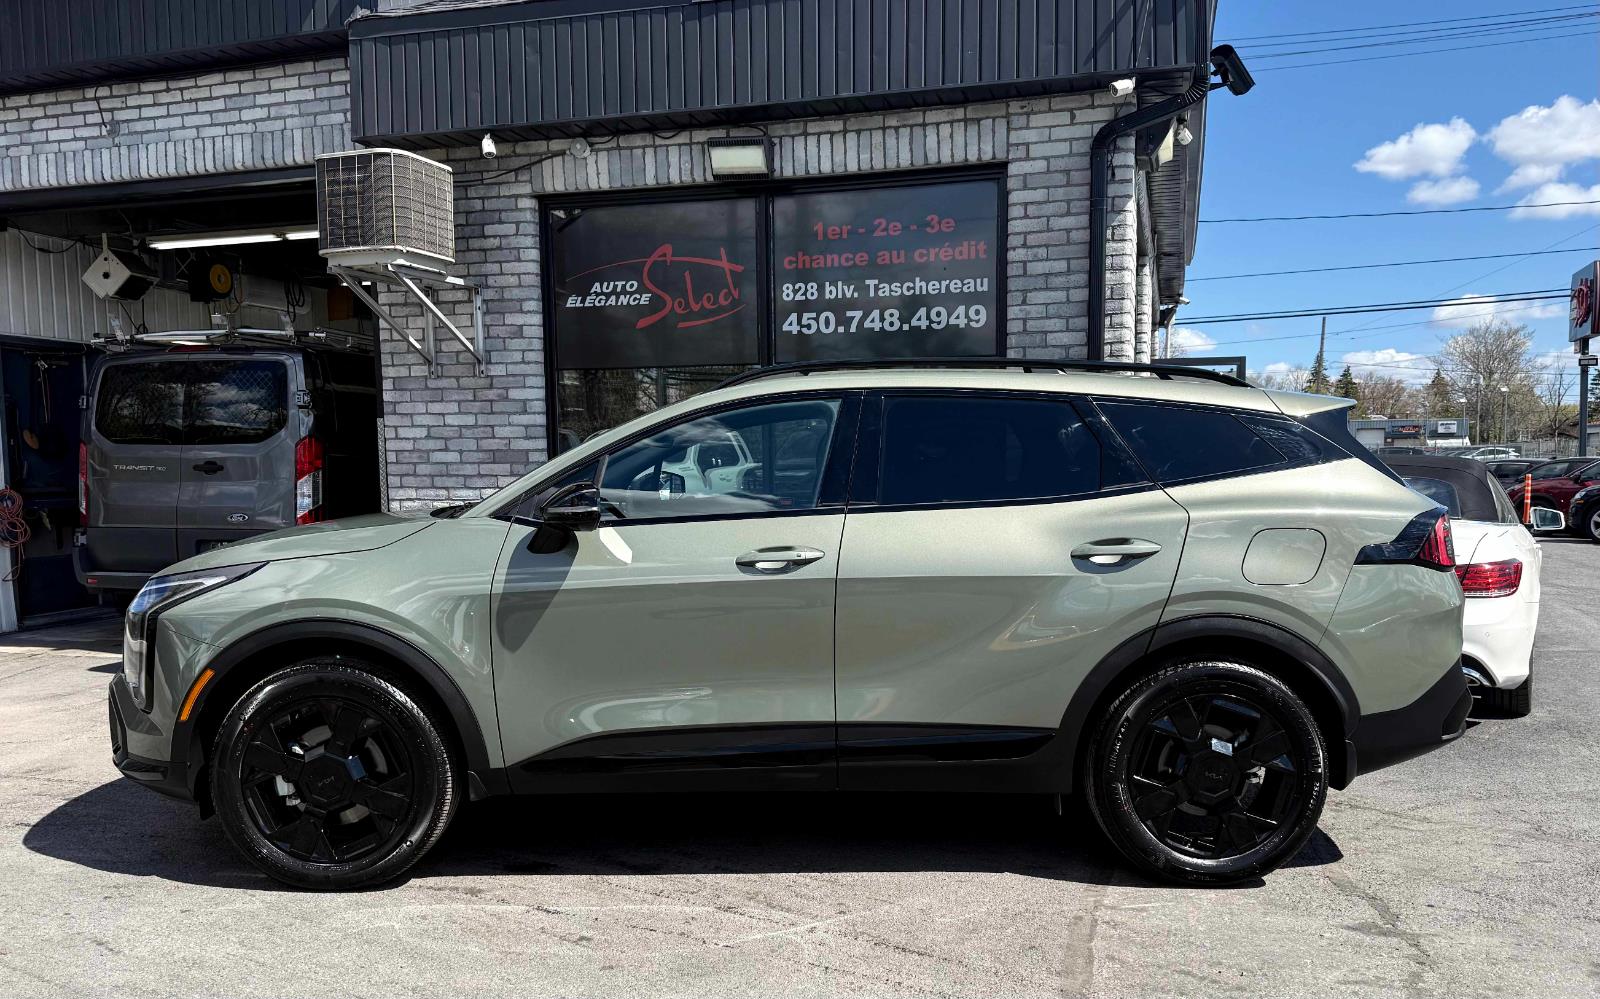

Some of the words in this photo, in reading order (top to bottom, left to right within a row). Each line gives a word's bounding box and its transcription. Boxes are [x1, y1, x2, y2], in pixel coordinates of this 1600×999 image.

[814, 221, 852, 241] 1er
[873, 217, 902, 237] 2e
[925, 214, 956, 234] 3e
[783, 252, 869, 270] chance
[876, 249, 905, 265] au
[914, 240, 988, 263] crédit
[590, 281, 638, 294] AUTO
[636, 243, 745, 329] Select
[781, 282, 818, 301] 828
[824, 280, 858, 299] blv.
[865, 277, 989, 298] Taschereau
[565, 293, 652, 308] ÉLÉGANCE
[782, 305, 988, 335] 450.748.4949
